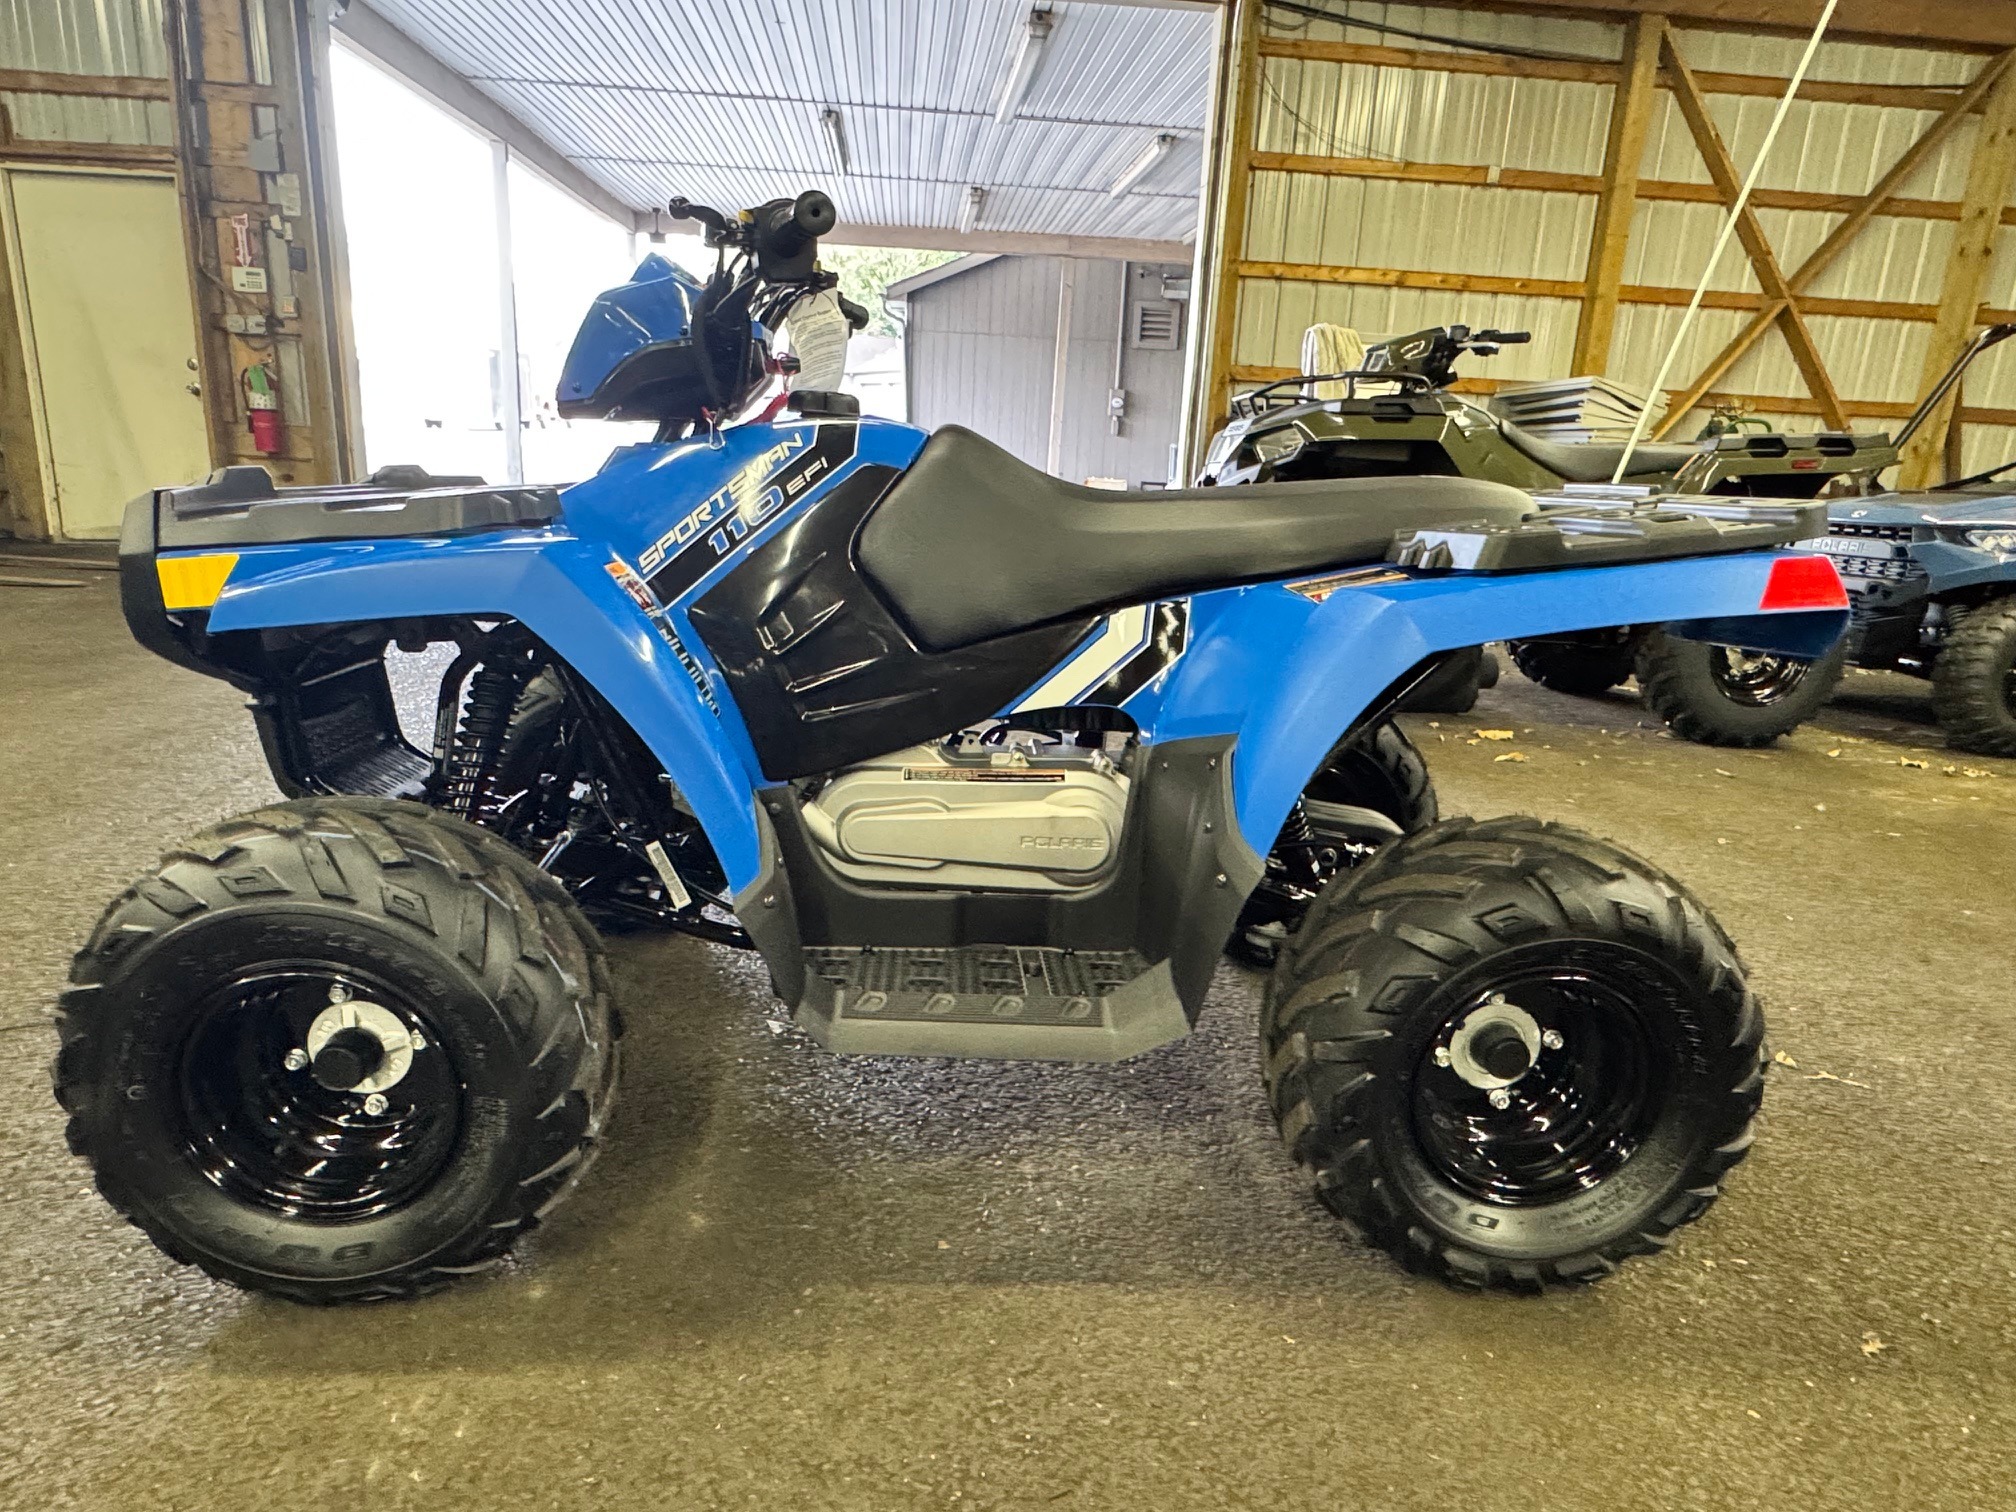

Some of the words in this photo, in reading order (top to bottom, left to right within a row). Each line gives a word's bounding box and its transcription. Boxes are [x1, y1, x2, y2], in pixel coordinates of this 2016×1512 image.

[638, 432, 804, 575] SPORTSMAN
[708, 485, 785, 556] 110
[786, 456, 828, 496] EFI
[1020, 836, 1105, 850] POLARIS
